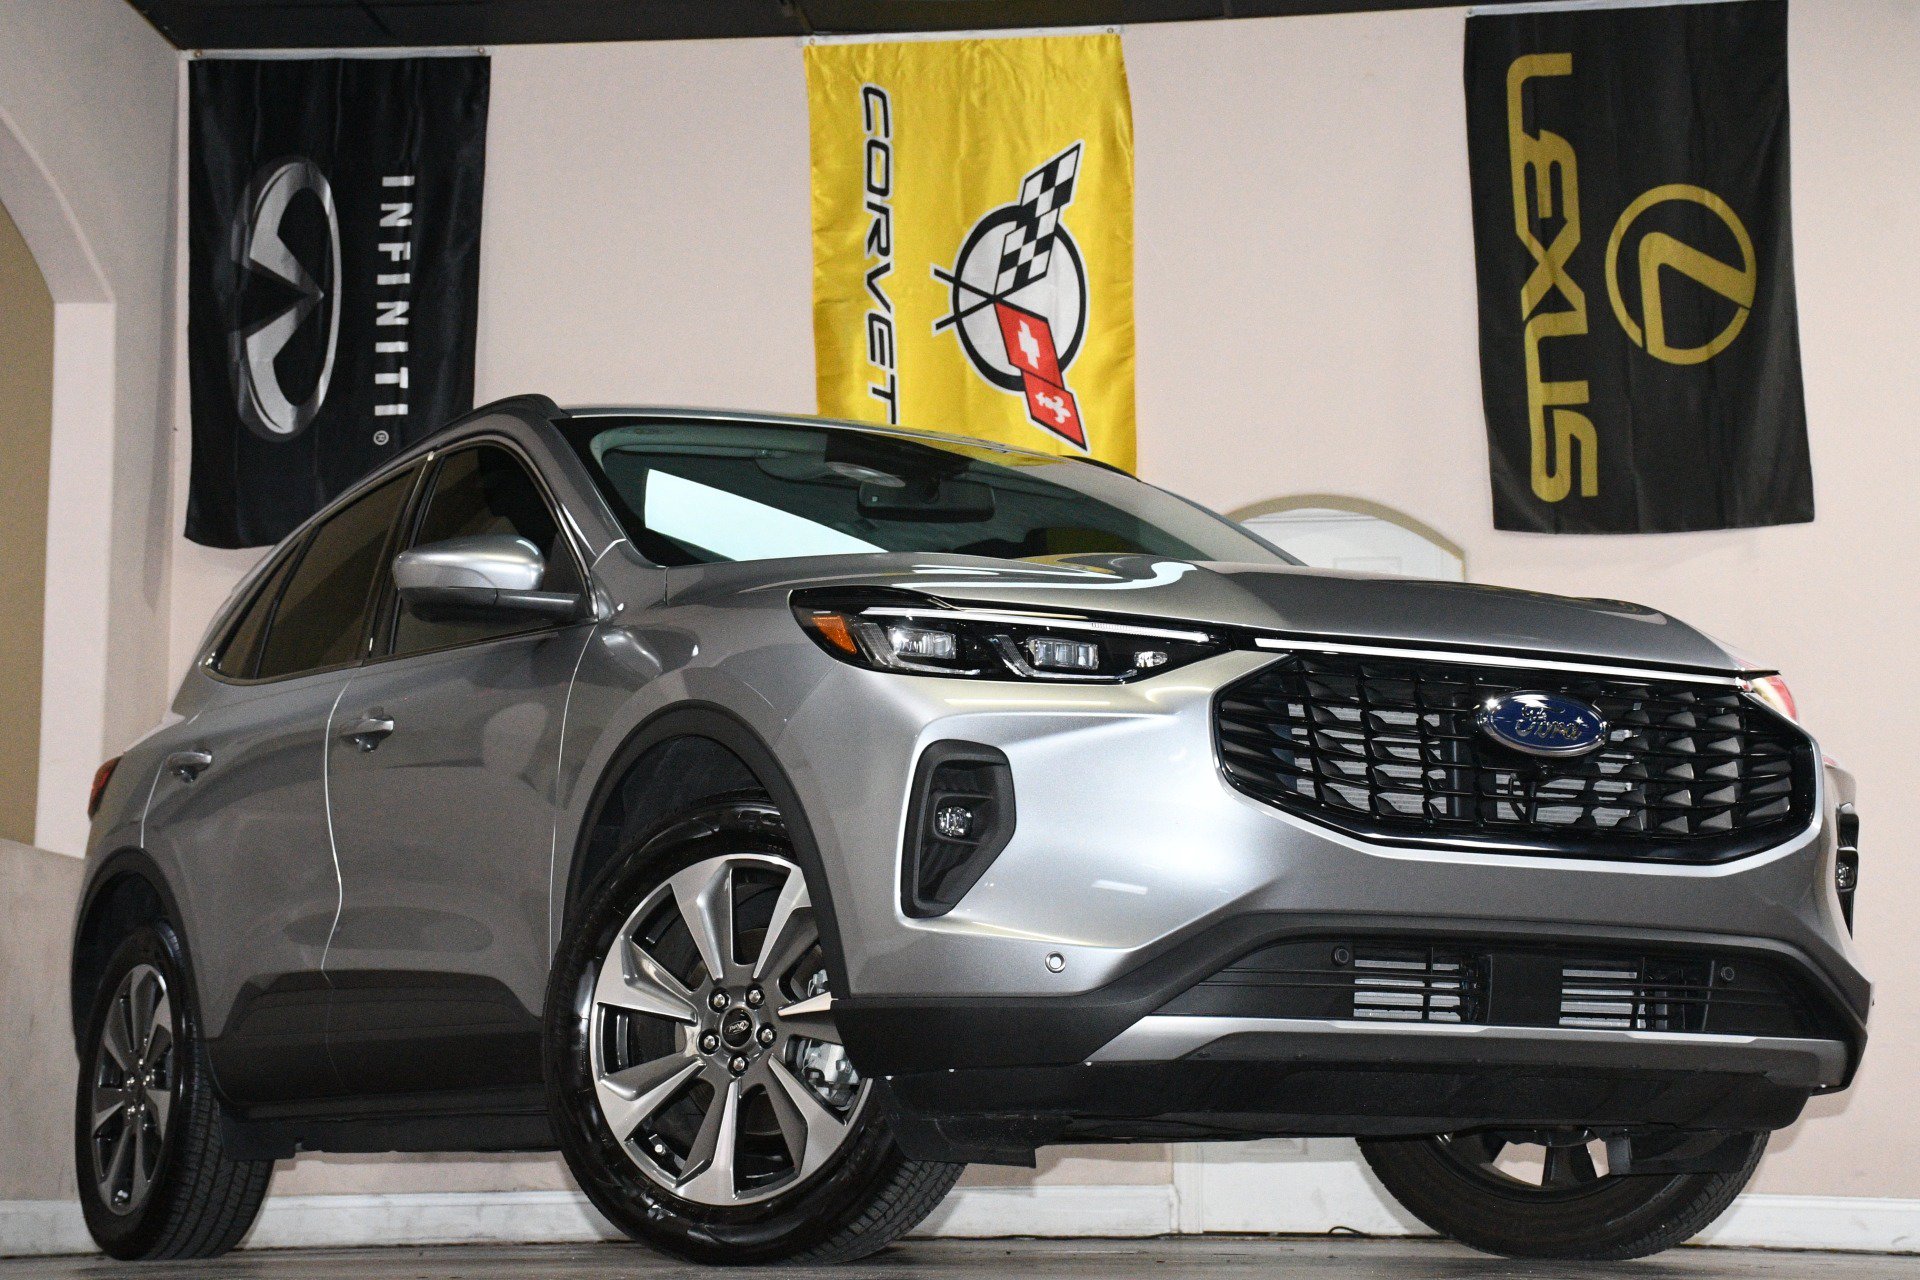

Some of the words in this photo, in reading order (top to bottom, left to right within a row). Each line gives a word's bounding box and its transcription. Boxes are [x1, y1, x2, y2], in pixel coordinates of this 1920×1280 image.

[374, 175, 416, 416] INFINITI
[1506, 52, 1598, 502] LEXUS
[1514, 703, 1588, 741] Ford
